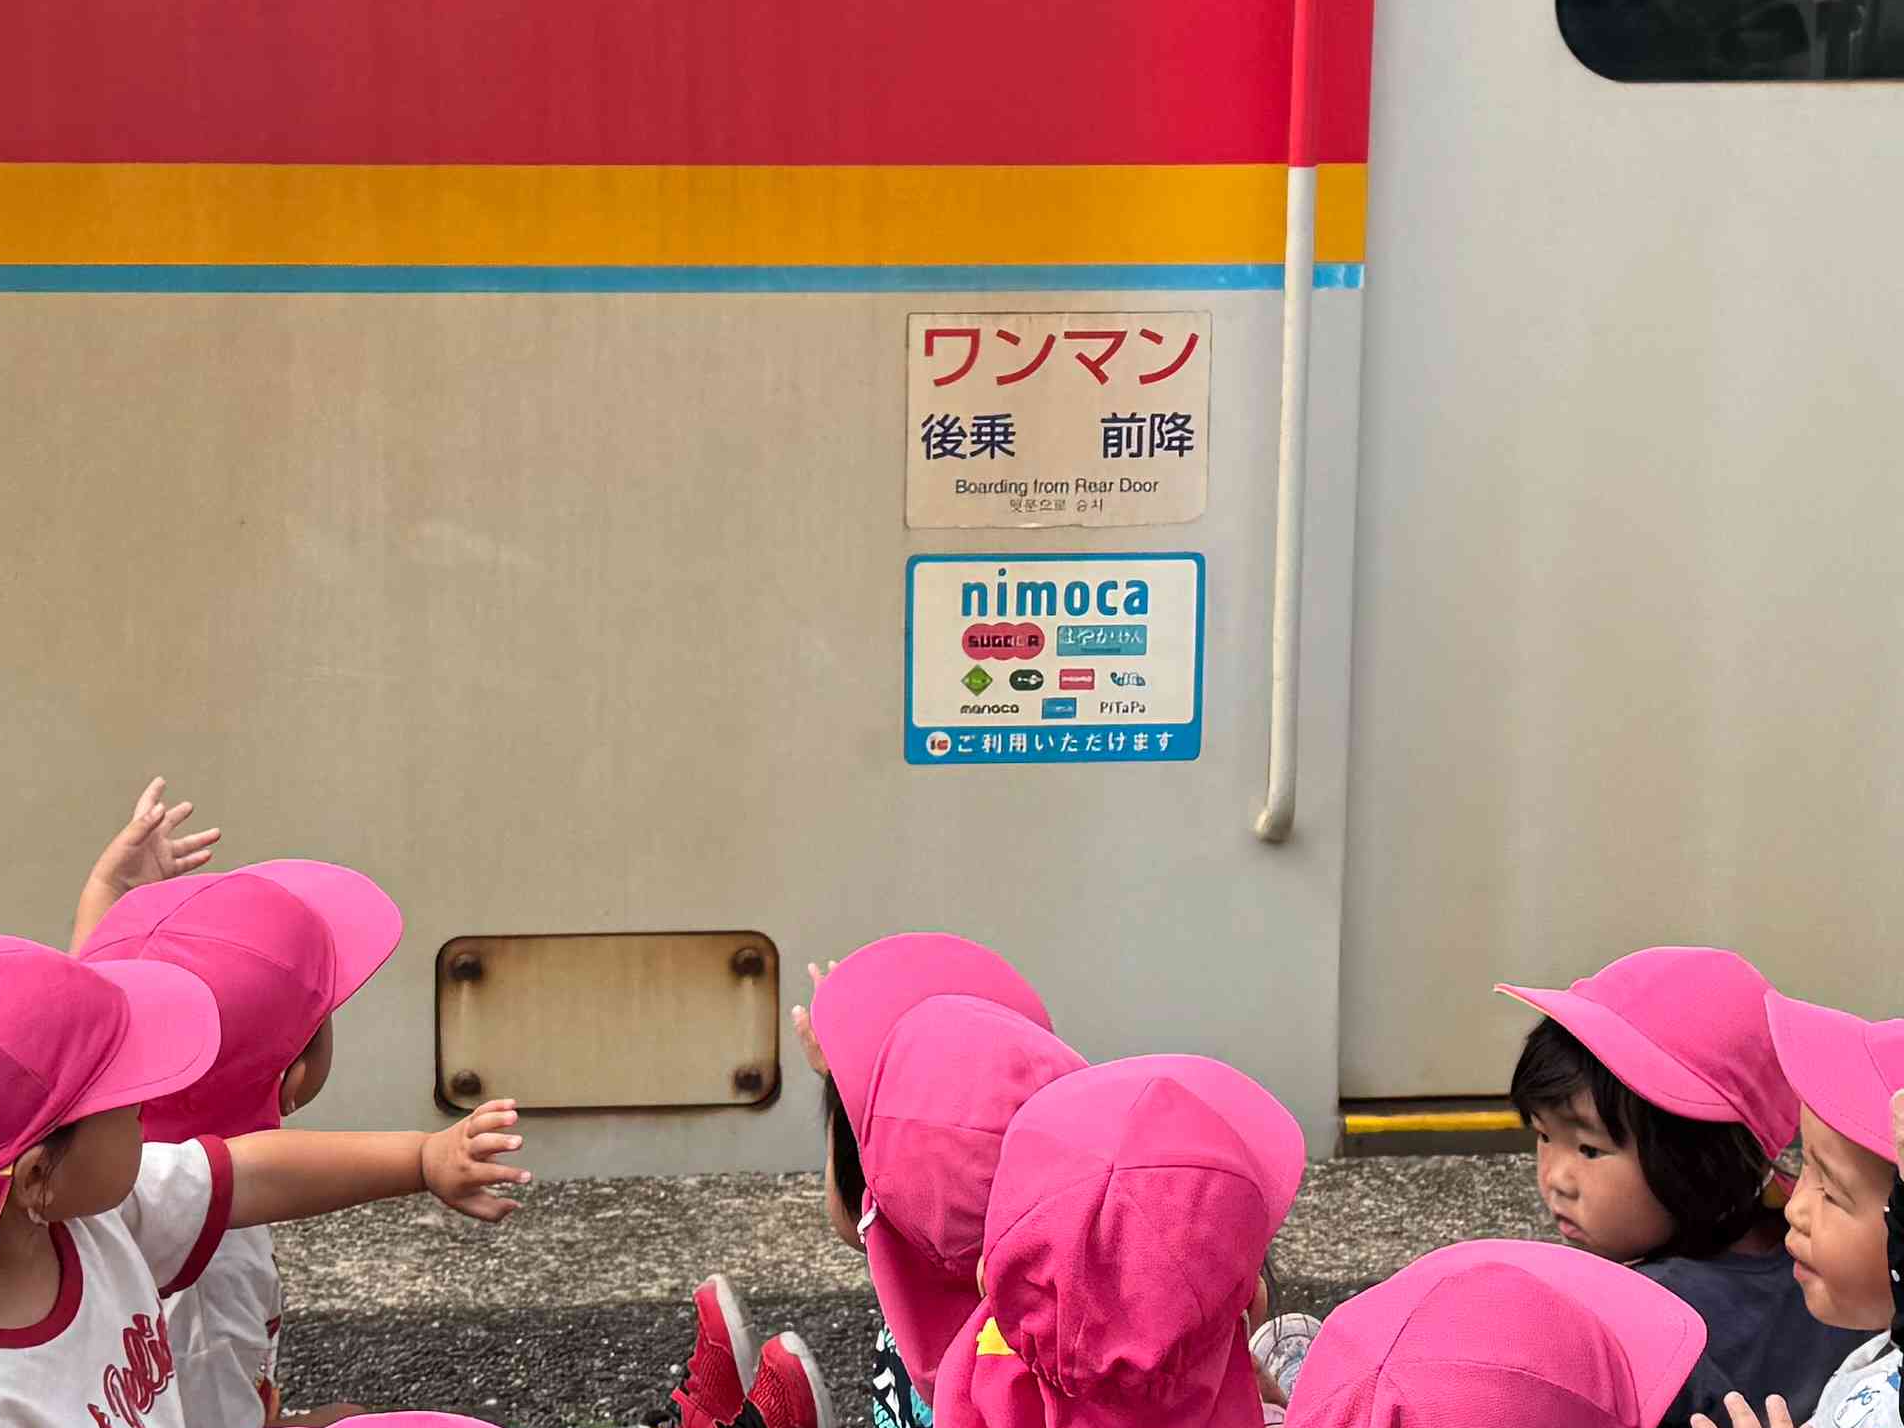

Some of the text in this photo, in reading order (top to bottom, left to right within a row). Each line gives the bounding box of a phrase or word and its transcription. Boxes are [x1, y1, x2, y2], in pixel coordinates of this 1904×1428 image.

[924, 328, 1200, 387] ワンマン
[921, 412, 1195, 460] 後乗 前降
[955, 477, 1159, 497] Boarding from Rear Door
[961, 568, 1149, 616] nimoca
[957, 731, 1174, 754] ご利用いただけます
